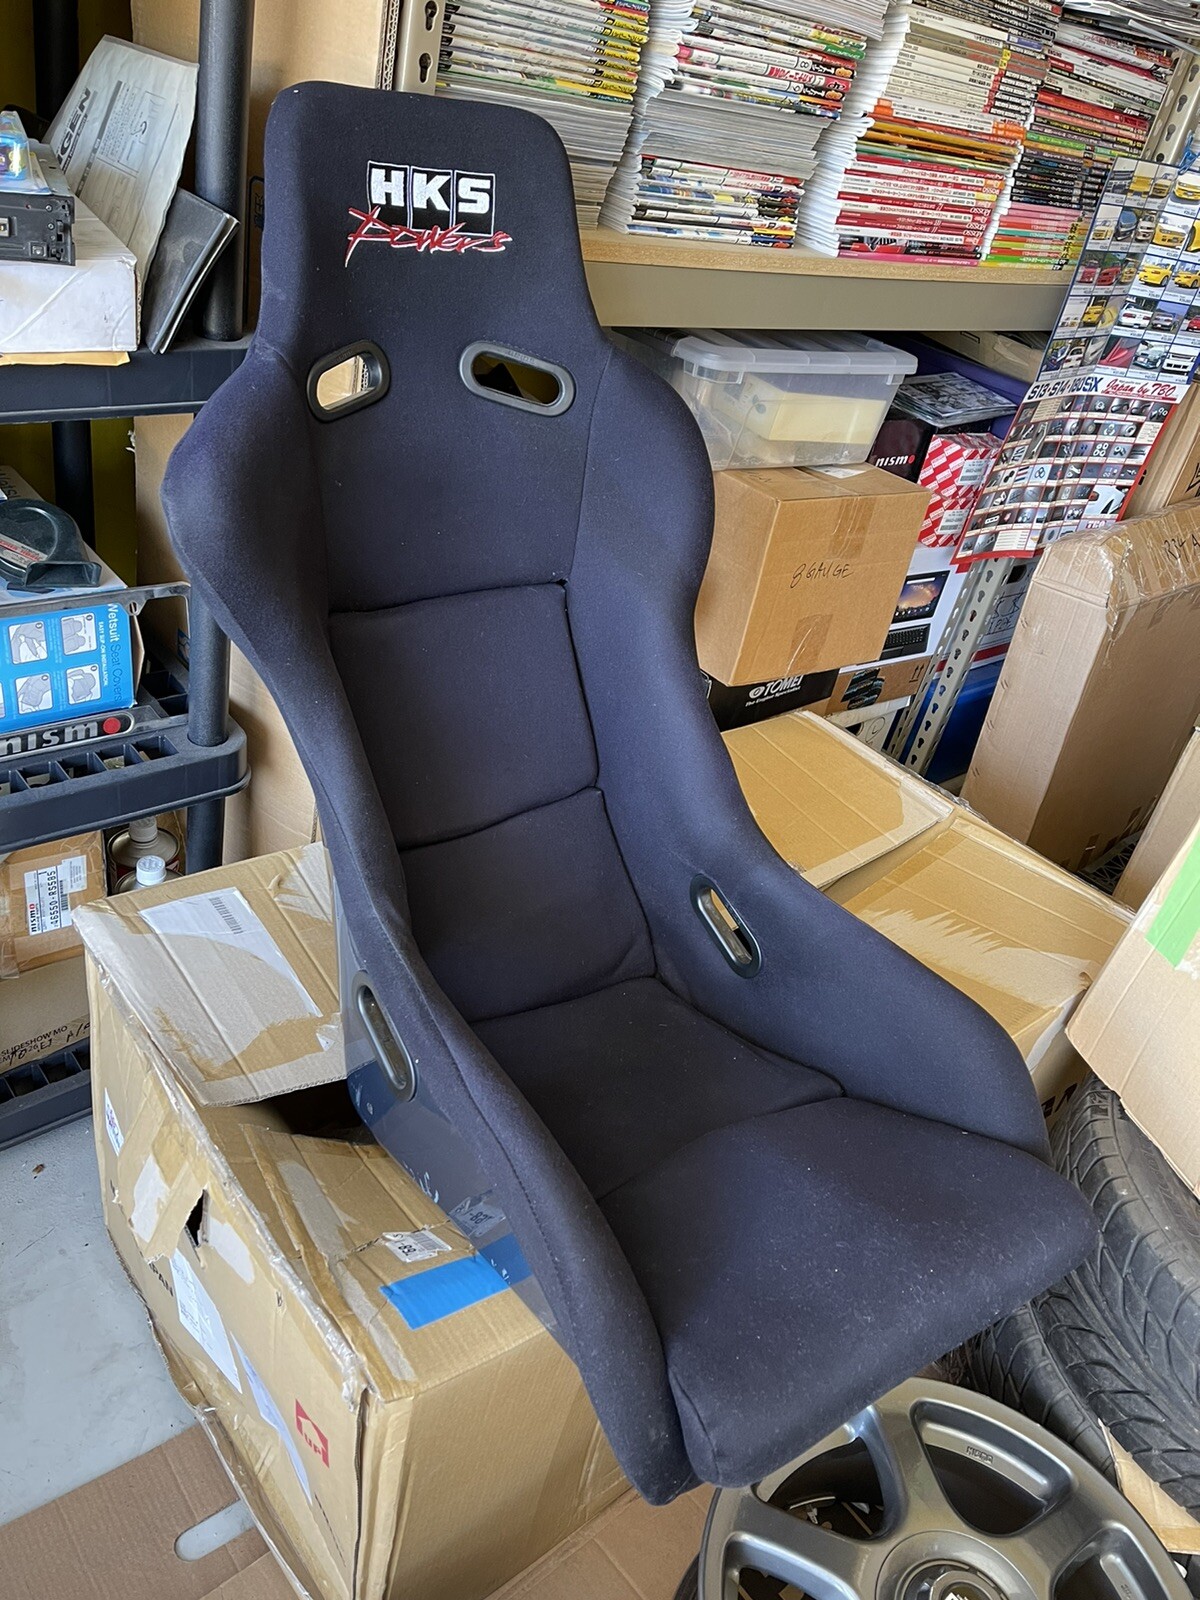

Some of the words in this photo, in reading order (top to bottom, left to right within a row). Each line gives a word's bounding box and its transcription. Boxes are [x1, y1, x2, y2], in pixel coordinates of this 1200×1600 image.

[371, 168, 491, 214] HKS
[1105, 378, 1136, 394] Japan
[111, 643, 121, 667] Seat
[112, 668, 123, 702] Covers
